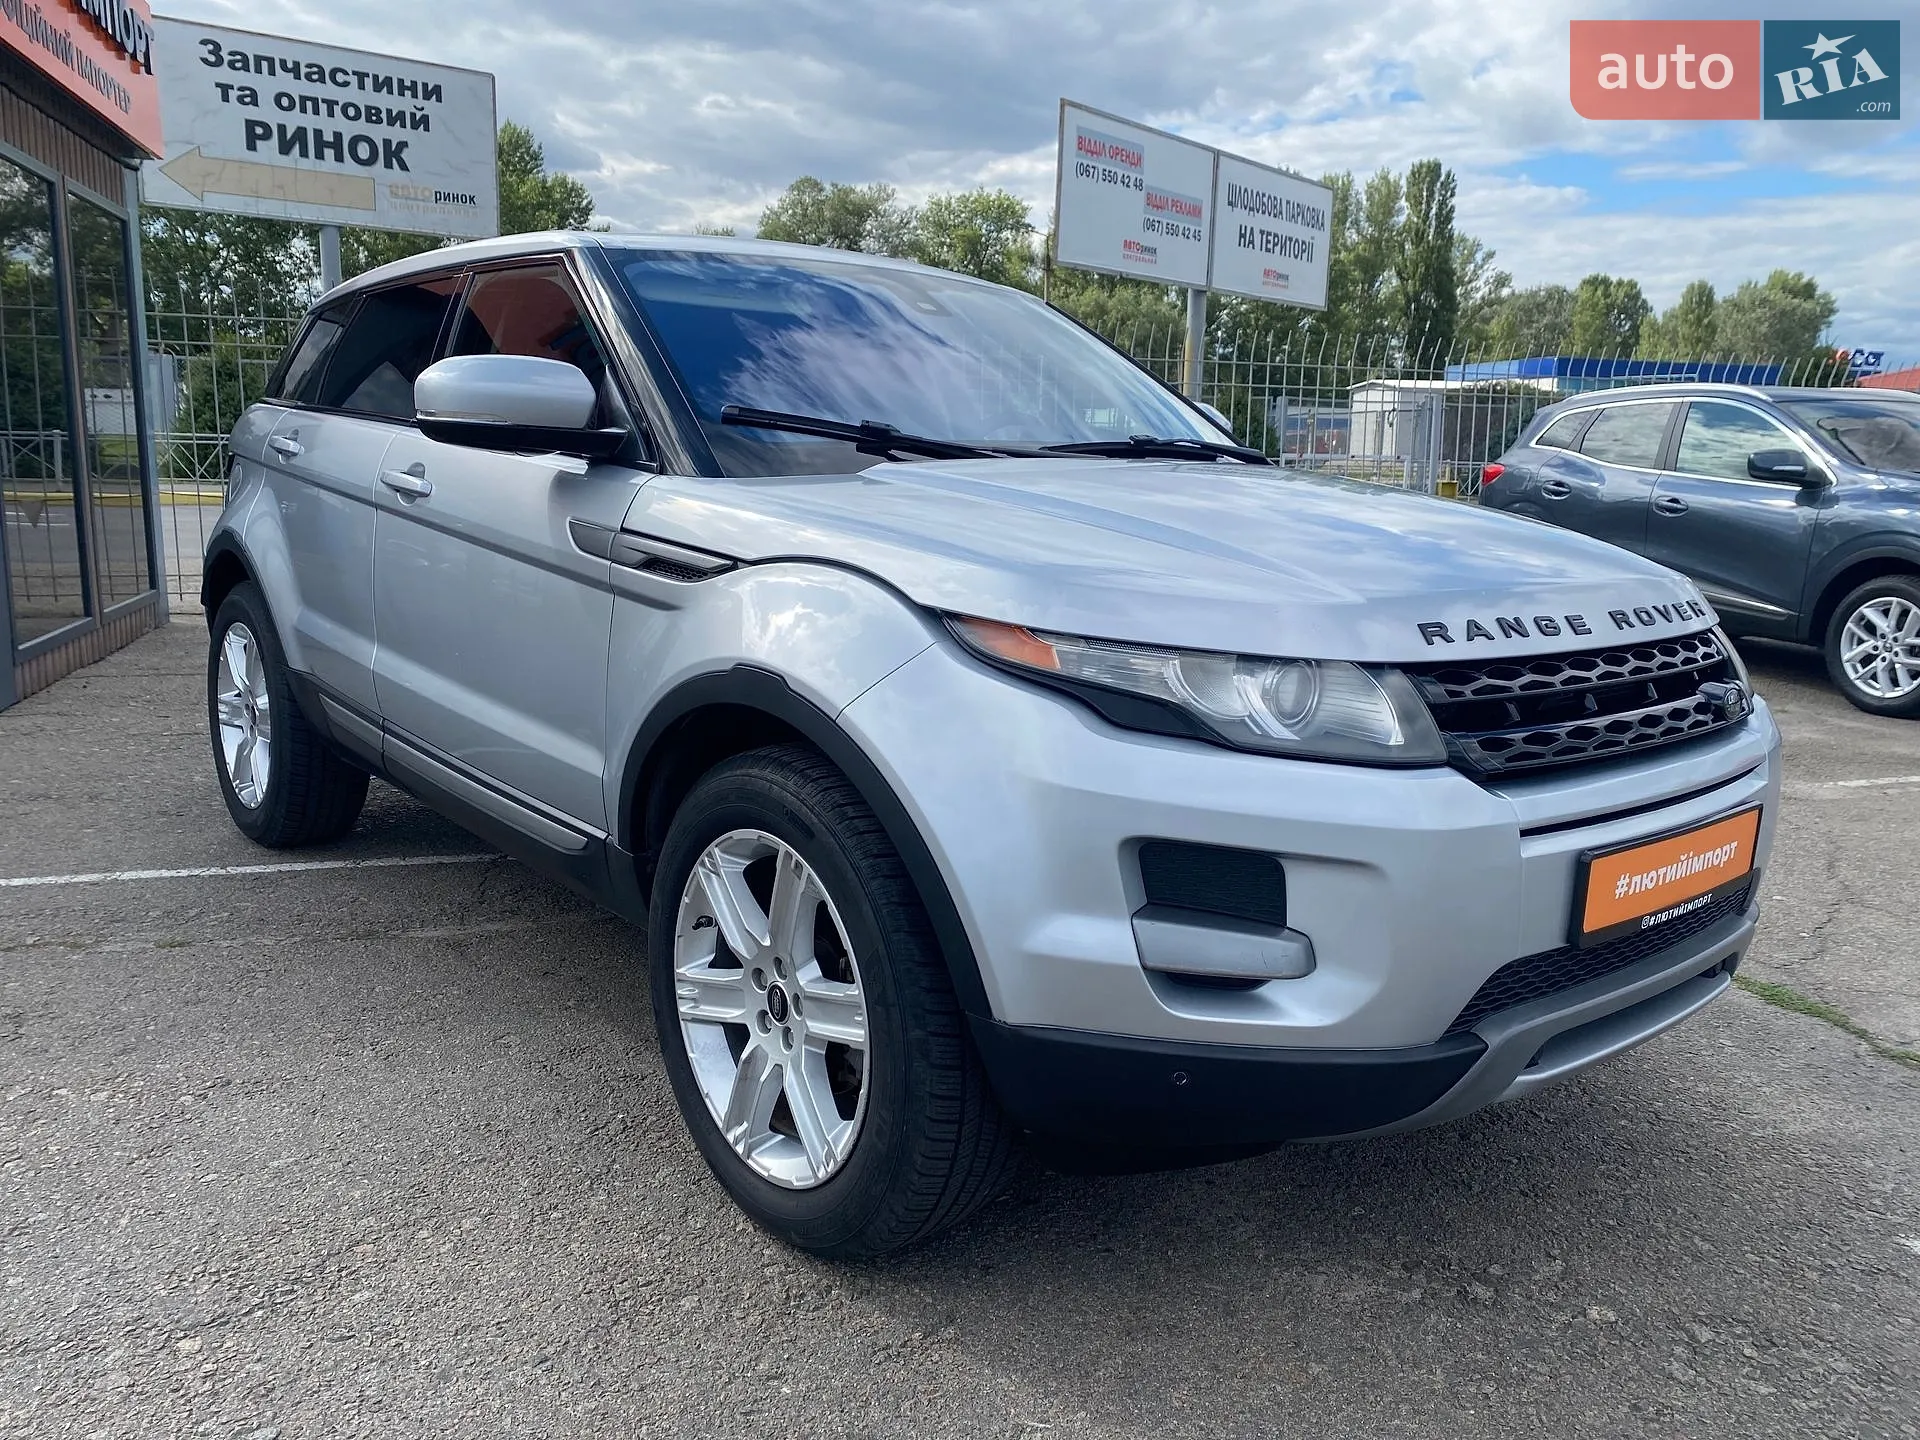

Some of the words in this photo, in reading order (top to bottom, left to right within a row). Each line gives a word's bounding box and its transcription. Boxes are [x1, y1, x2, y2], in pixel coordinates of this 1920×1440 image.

[198, 37, 444, 104] Запчастини
[214, 81, 260, 108] та
[273, 91, 431, 132] оптовий
[243, 117, 411, 172] РИНОК
[1077, 136, 1107, 158] ВІДДІЛ
[1108, 144, 1142, 168] ОРЕНДИ
[1075, 161, 1100, 183] (067)
[1101, 167, 1118, 185] 550
[1120, 173, 1131, 189] 42
[1133, 176, 1144, 191] 48
[1145, 191, 1170, 213] ВІДДІЛ
[1170, 198, 1203, 219] РЕКЛАМИ
[1227, 182, 1284, 220] ЦІЛОДОБОВА
[1285, 199, 1325, 232] ПАРКОВКА
[1142, 216, 1164, 237] (067)
[1165, 221, 1180, 237] 550
[1181, 224, 1192, 240] 42
[1192, 229, 1203, 243] 45
[1238, 223, 1256, 250] НА
[1259, 228, 1316, 264] ТЕРИТОРІЇ
[1416, 614, 1594, 646] RANGE
[1606, 599, 1707, 631] ROVER
[1614, 840, 1739, 900] #лютийімпорт
